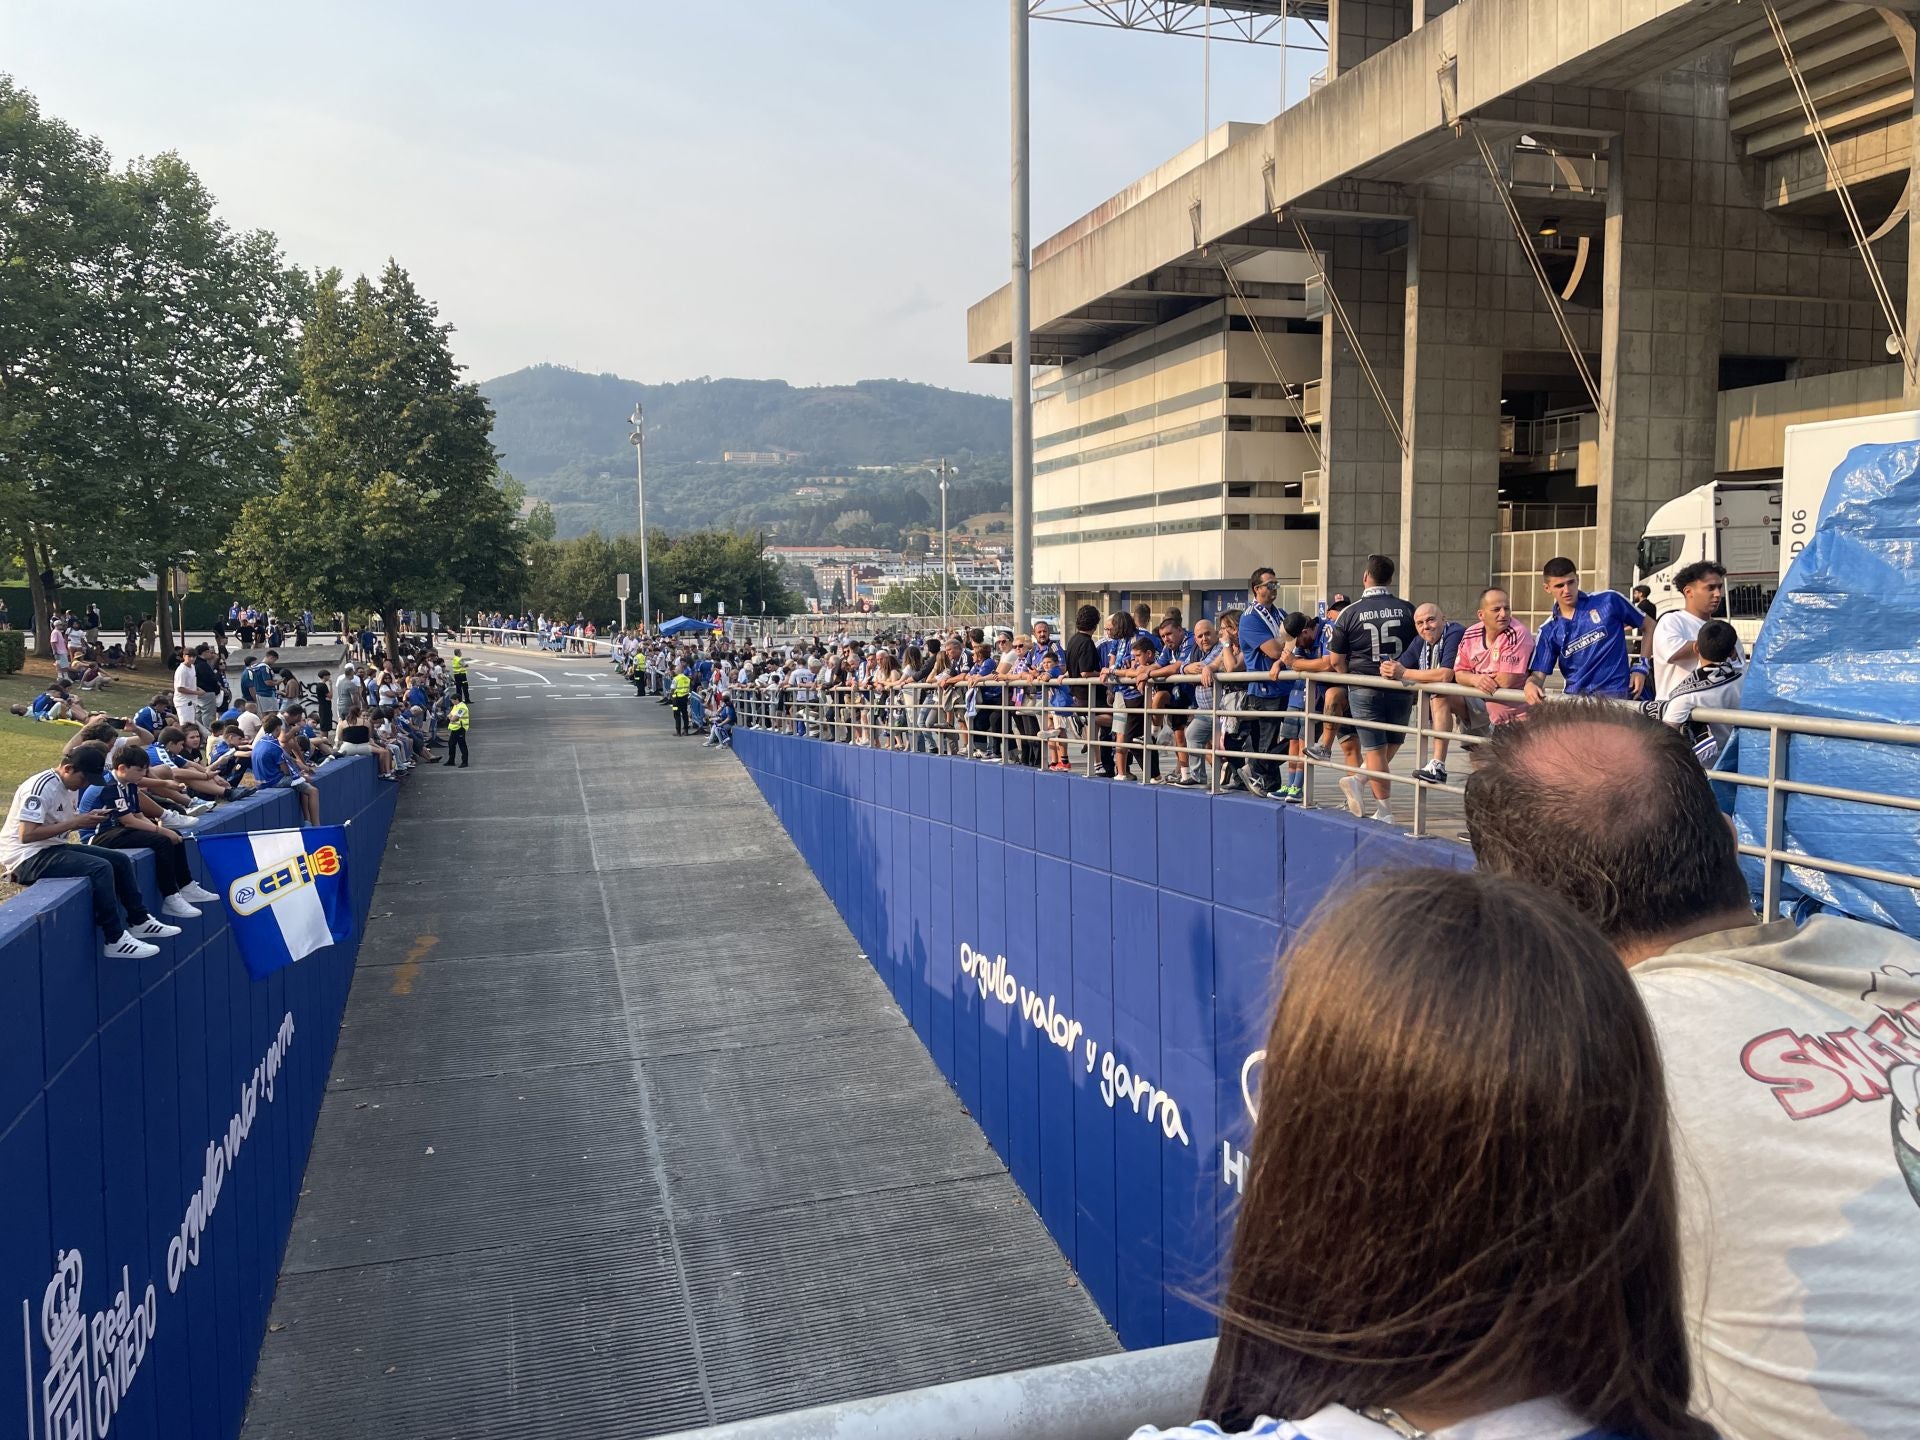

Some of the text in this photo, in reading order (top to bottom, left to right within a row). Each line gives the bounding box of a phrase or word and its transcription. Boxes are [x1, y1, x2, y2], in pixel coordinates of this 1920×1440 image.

[1360, 608, 1404, 621] ARDA GÜLER
[1363, 620, 1403, 662] 15
[1565, 631, 1606, 656] ASTURIANA
[224, 1068, 259, 1171] valor
[259, 1057, 267, 1099] y
[267, 1011, 295, 1103] garra
[1021, 986, 1082, 1052] valor
[1086, 1039, 1097, 1073] y
[1101, 1052, 1189, 1146] garra
[91, 1265, 130, 1382] Real
[95, 1284, 156, 1439] OVIEDO
